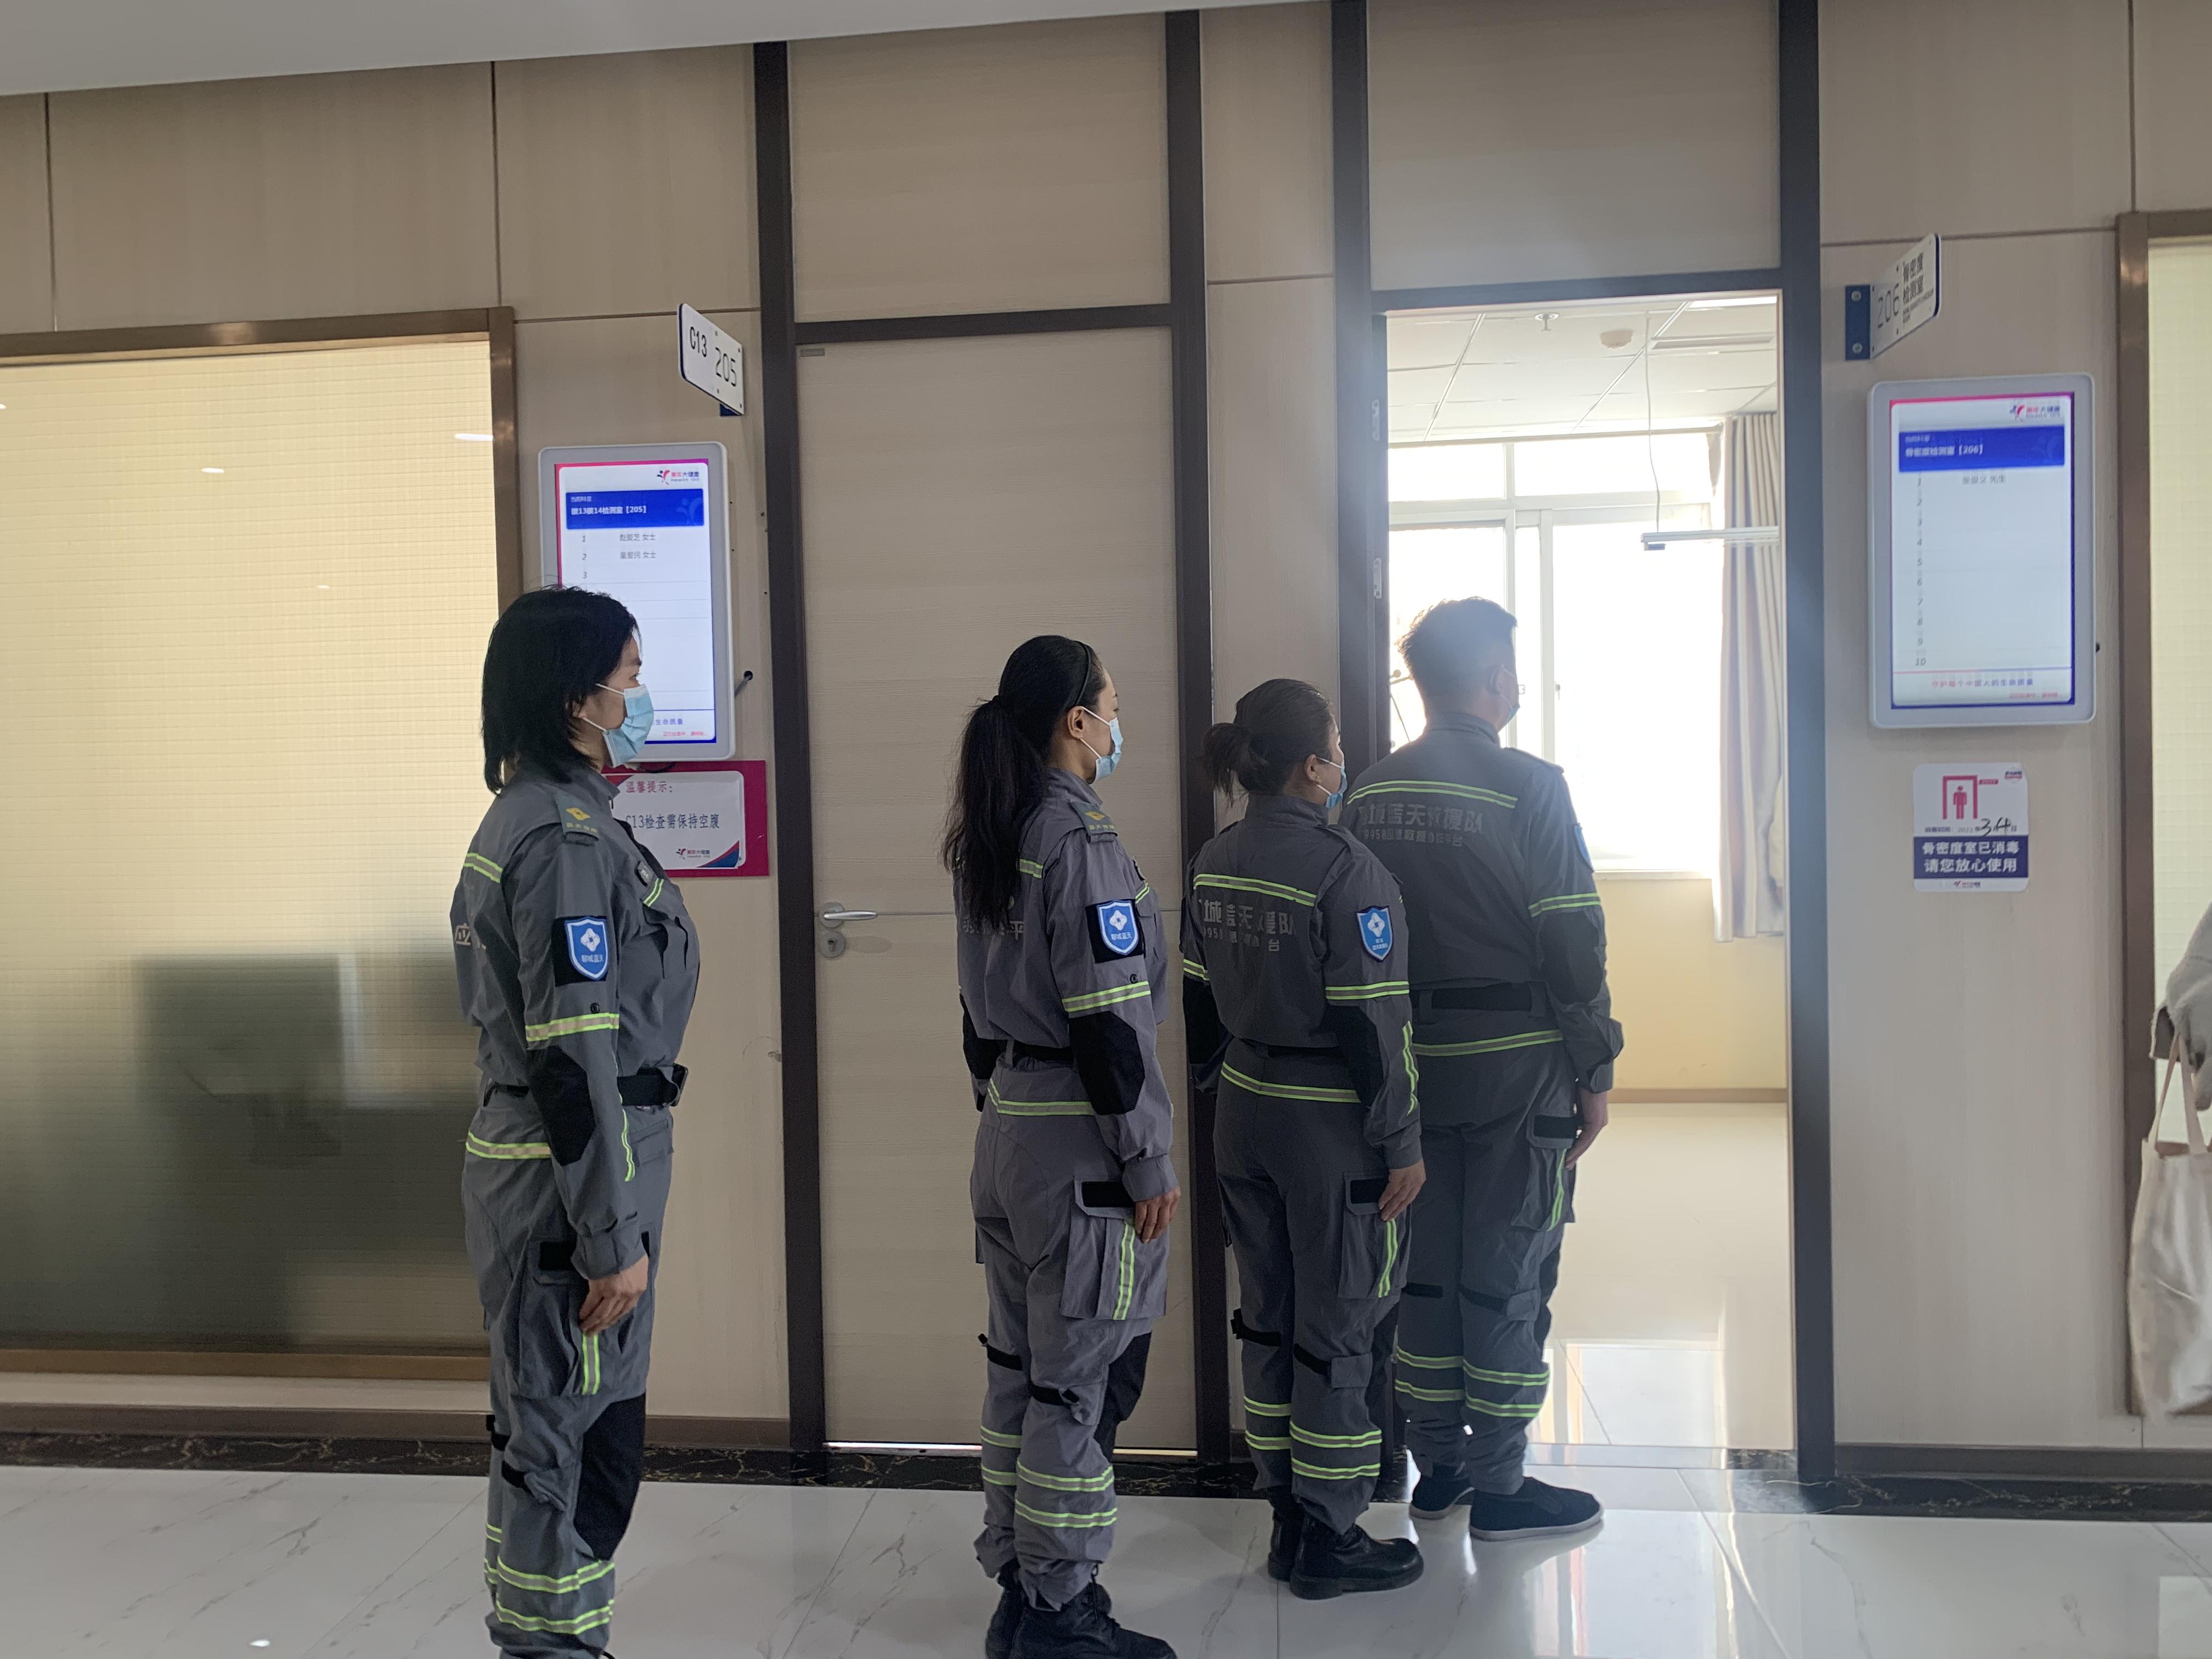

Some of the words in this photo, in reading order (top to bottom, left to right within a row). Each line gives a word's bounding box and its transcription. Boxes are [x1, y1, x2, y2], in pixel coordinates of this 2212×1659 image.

[1877, 283, 1900, 329] 206
[690, 326, 708, 358] C13
[715, 346, 737, 387] 205
[642, 533, 656, 541] 女士
[642, 550, 657, 558] 女士
[1917, 558, 1922, 566] 5
[1917, 578, 1923, 586] 6
[1917, 597, 1923, 606] 7
[1917, 637, 1923, 646] 9
[1915, 657, 1927, 666] 10
[1922, 840, 2020, 855] 骨密度室已消毒
[1923, 857, 2018, 873] 请您放心使用
